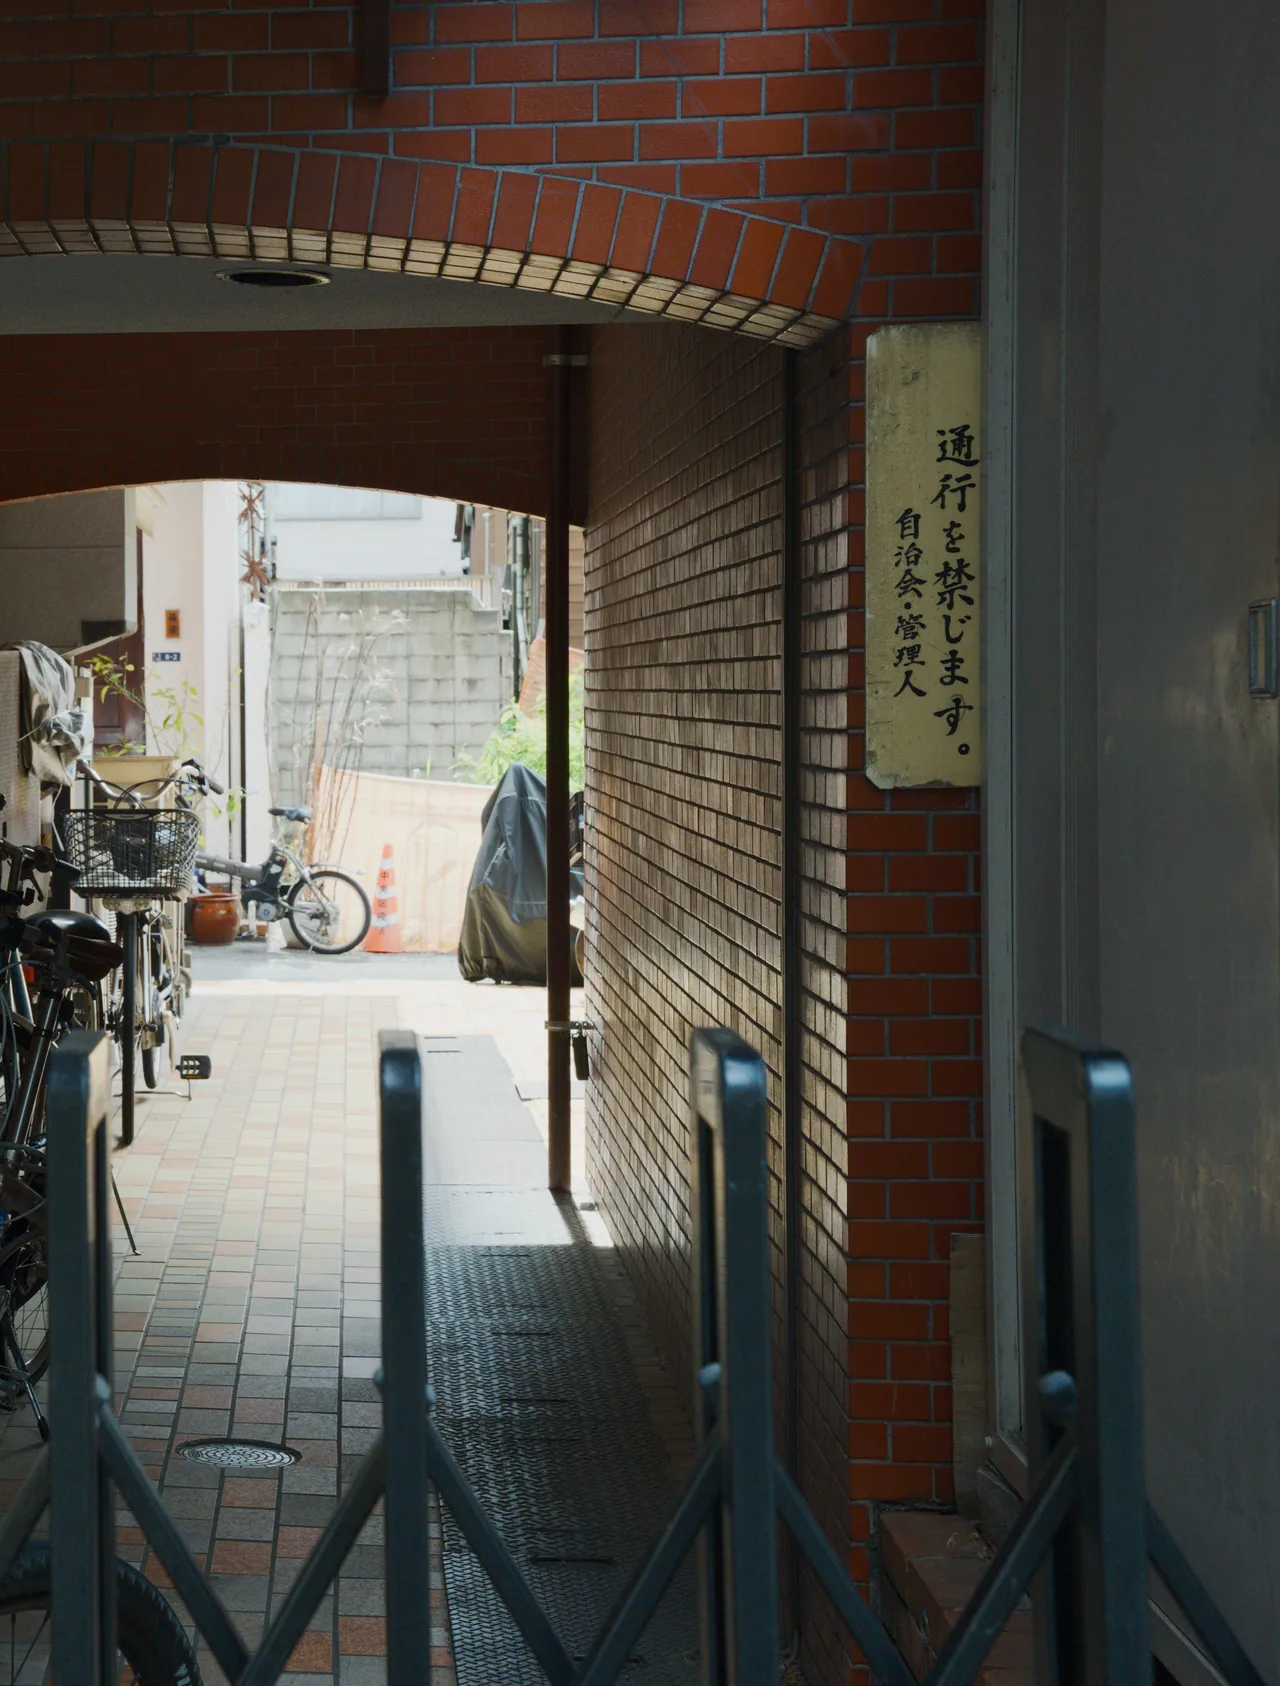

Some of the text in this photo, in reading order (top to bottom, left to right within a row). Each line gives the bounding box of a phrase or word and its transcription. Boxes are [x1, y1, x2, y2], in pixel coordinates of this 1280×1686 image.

[893, 507, 927, 698] 自治会・管理人
[930, 424, 980, 756] 通行を禁じます。
